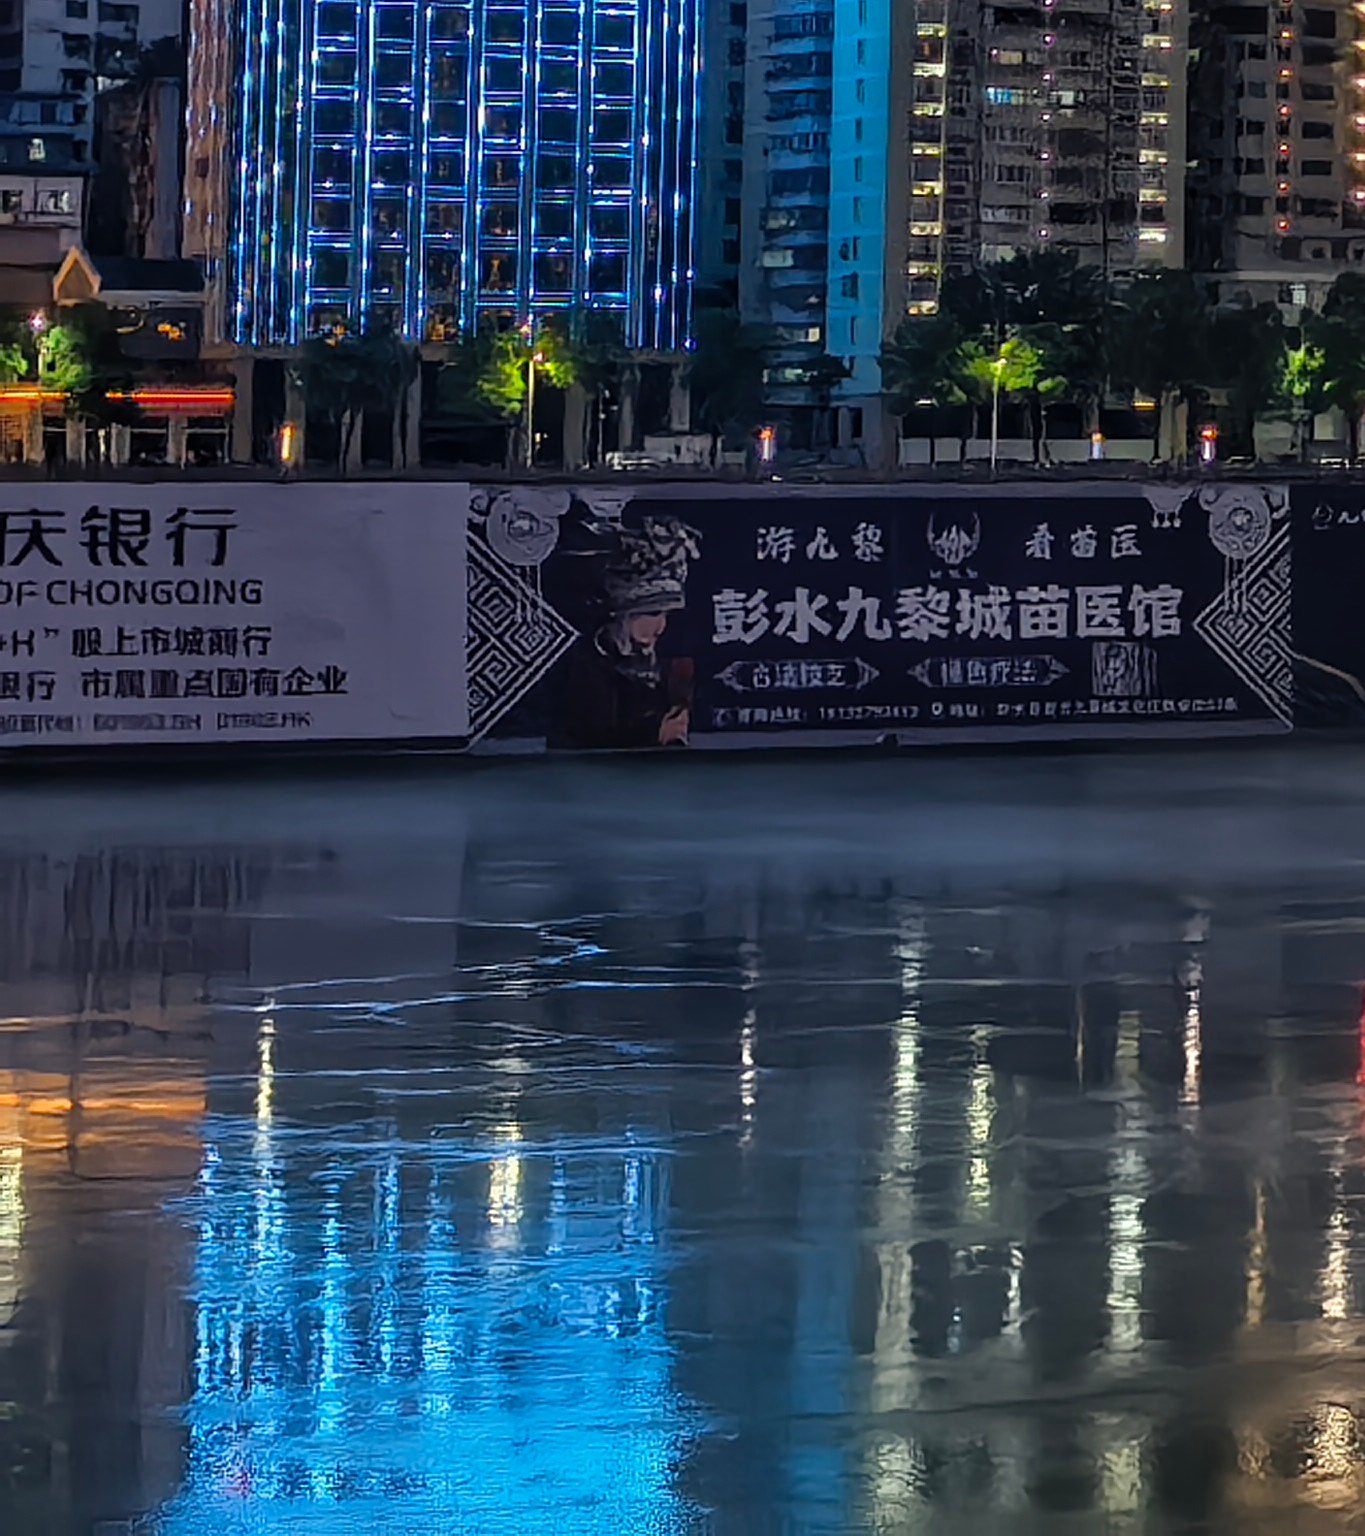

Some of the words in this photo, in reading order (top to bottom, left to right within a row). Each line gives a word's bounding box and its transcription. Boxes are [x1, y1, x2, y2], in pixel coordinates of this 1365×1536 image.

[0, 505, 239, 567] 庆银行
[756, 522, 885, 563] 游九黎
[1025, 522, 1143, 560] 看苗医
[46, 578, 264, 606] CHONGQING
[712, 584, 1184, 645] 彭水九黎城苗医馆
